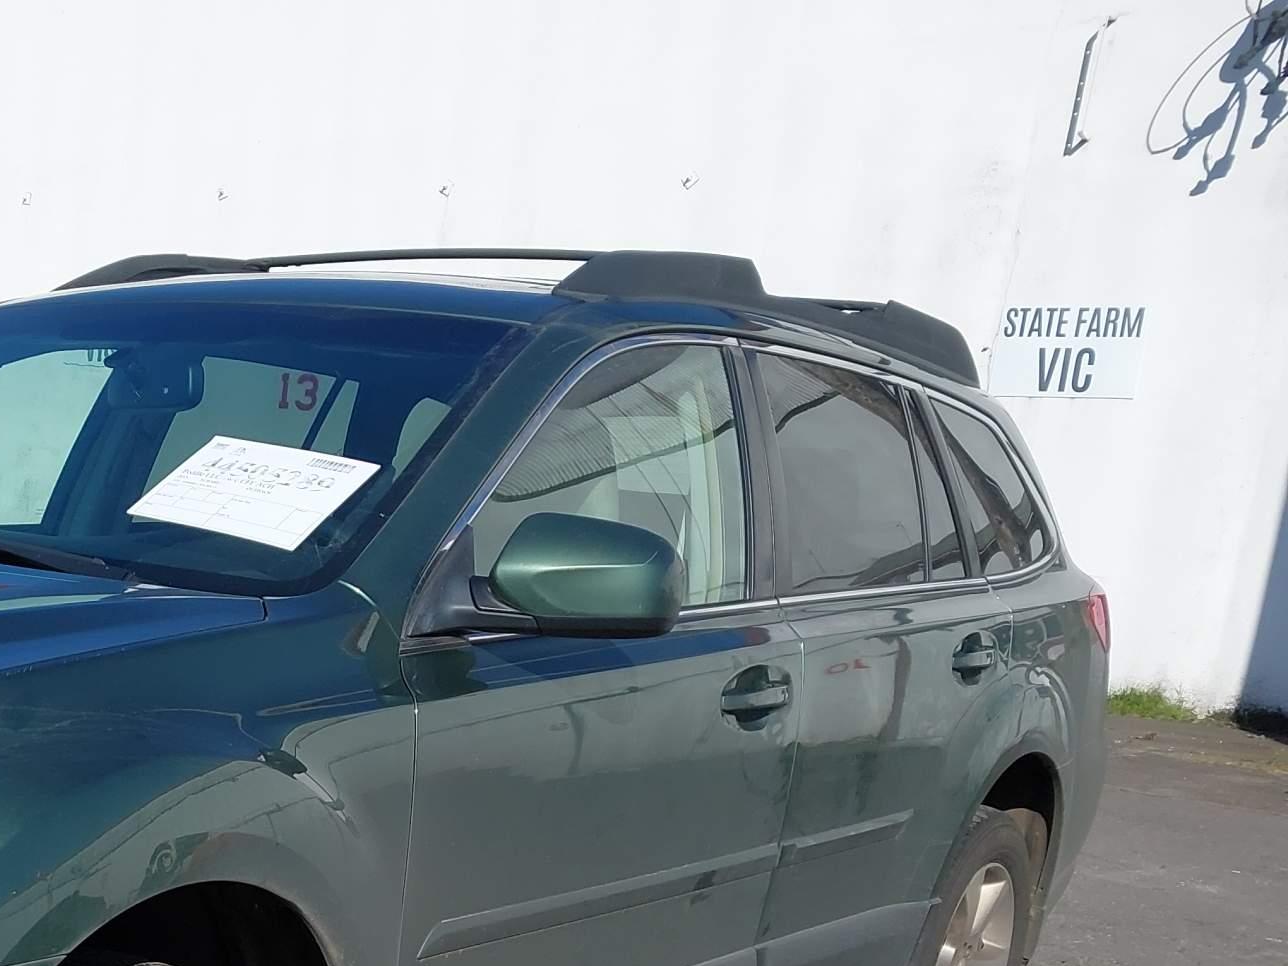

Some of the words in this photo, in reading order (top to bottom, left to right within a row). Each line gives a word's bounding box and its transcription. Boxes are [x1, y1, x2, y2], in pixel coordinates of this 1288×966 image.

[1003, 307, 1071, 338] STATE
[1074, 307, 1146, 338] FARM
[1037, 347, 1096, 393] VIC
[277, 372, 320, 412] 13
